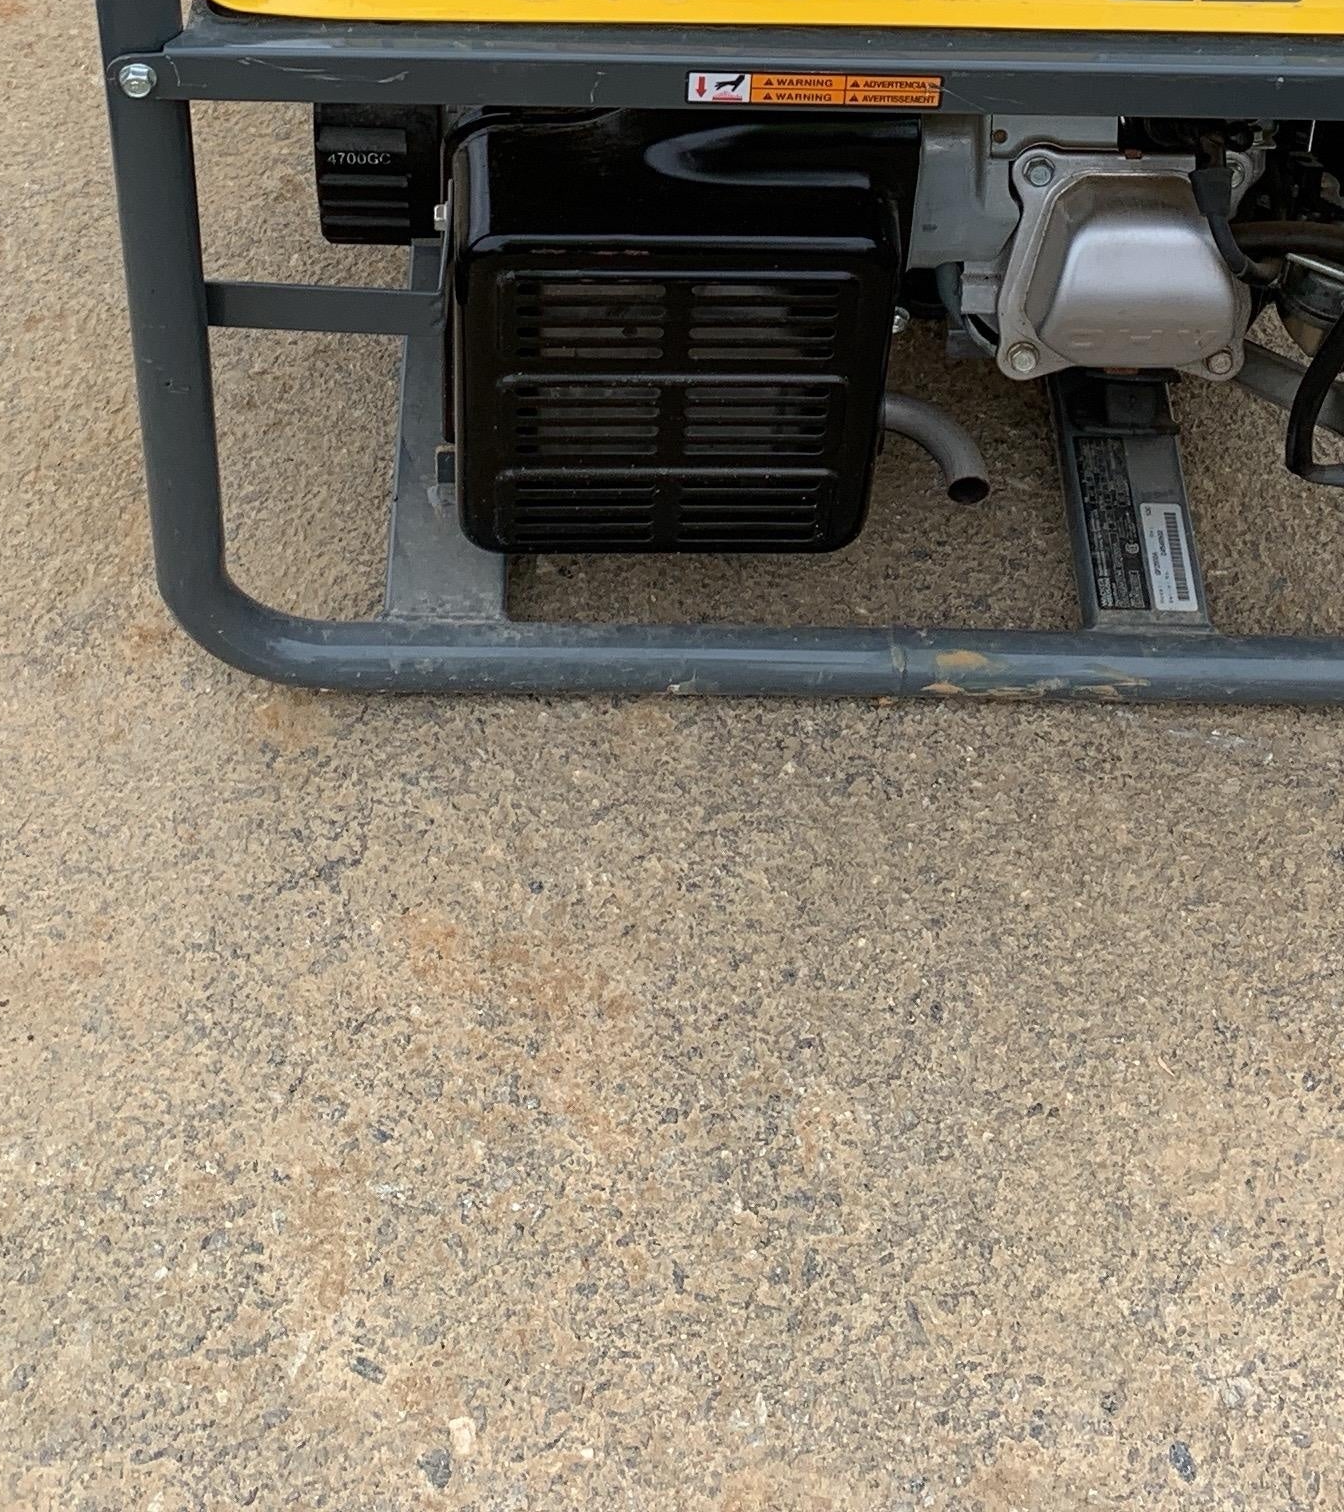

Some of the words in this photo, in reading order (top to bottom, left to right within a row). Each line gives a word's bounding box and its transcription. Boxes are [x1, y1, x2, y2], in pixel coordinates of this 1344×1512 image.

[776, 79, 833, 87] WARNING
[863, 80, 927, 89] ADVERTENCIA
[776, 93, 832, 102] WARNING
[861, 95, 935, 103] AVERTISSEMENT
[327, 152, 391, 165] 4700GC
